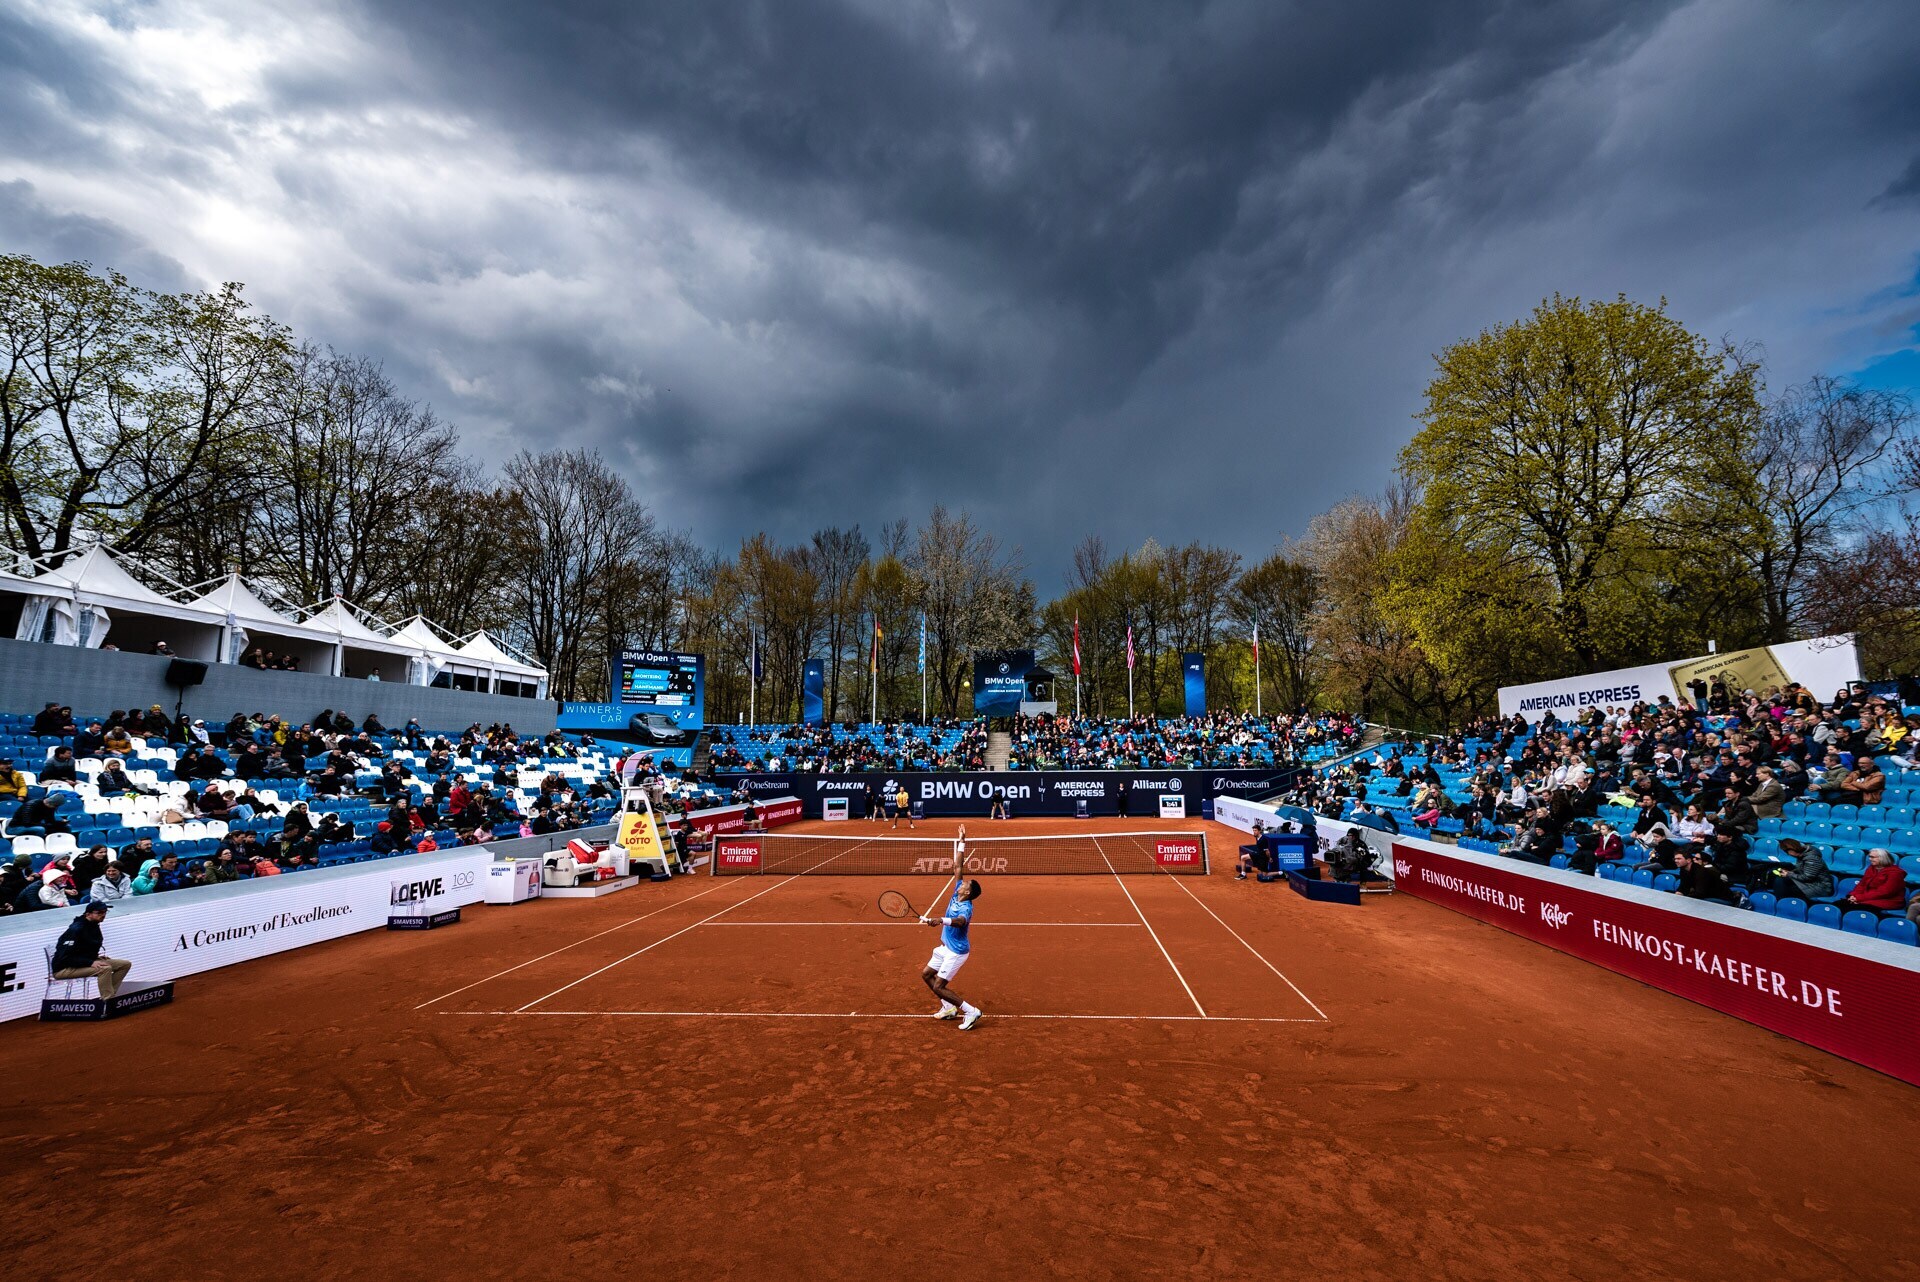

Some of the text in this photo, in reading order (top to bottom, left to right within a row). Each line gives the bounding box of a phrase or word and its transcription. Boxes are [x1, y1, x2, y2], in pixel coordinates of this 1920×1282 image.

[622, 652, 668, 662] BMW Open
[1693, 653, 1750, 675] AMERICAN EXPRESS
[1005, 678, 1024, 686] Open
[1520, 685, 1641, 711] AMERICAN EXPRESS
[565, 705, 622, 714] WINNER'S
[600, 714, 622, 723] CAR
[750, 781, 789, 789] OneStream
[826, 782, 865, 790] DAIKIN
[1132, 780, 1167, 789] Allianz
[1226, 780, 1270, 789] OneStream
[921, 781, 973, 799] BMW
[978, 781, 1030, 799] Open
[625, 837, 650, 845] LOTTO
[721, 846, 758, 856] Emirates
[1157, 844, 1197, 854] Emirates
[910, 857, 1008, 872] ATP OUR
[390, 877, 445, 906] LOEWE.
[434, 912, 457, 923] SMAVESTO
[173, 904, 353, 952] A Century of Excellence.
[1395, 859, 1843, 1017] Käfer FEINKOST-KAEFER.DE Käfer FEINKOST-KAEFER.DE
[116, 989, 164, 1009] SMAVESTO
[50, 1004, 95, 1012] SMAVESTO
